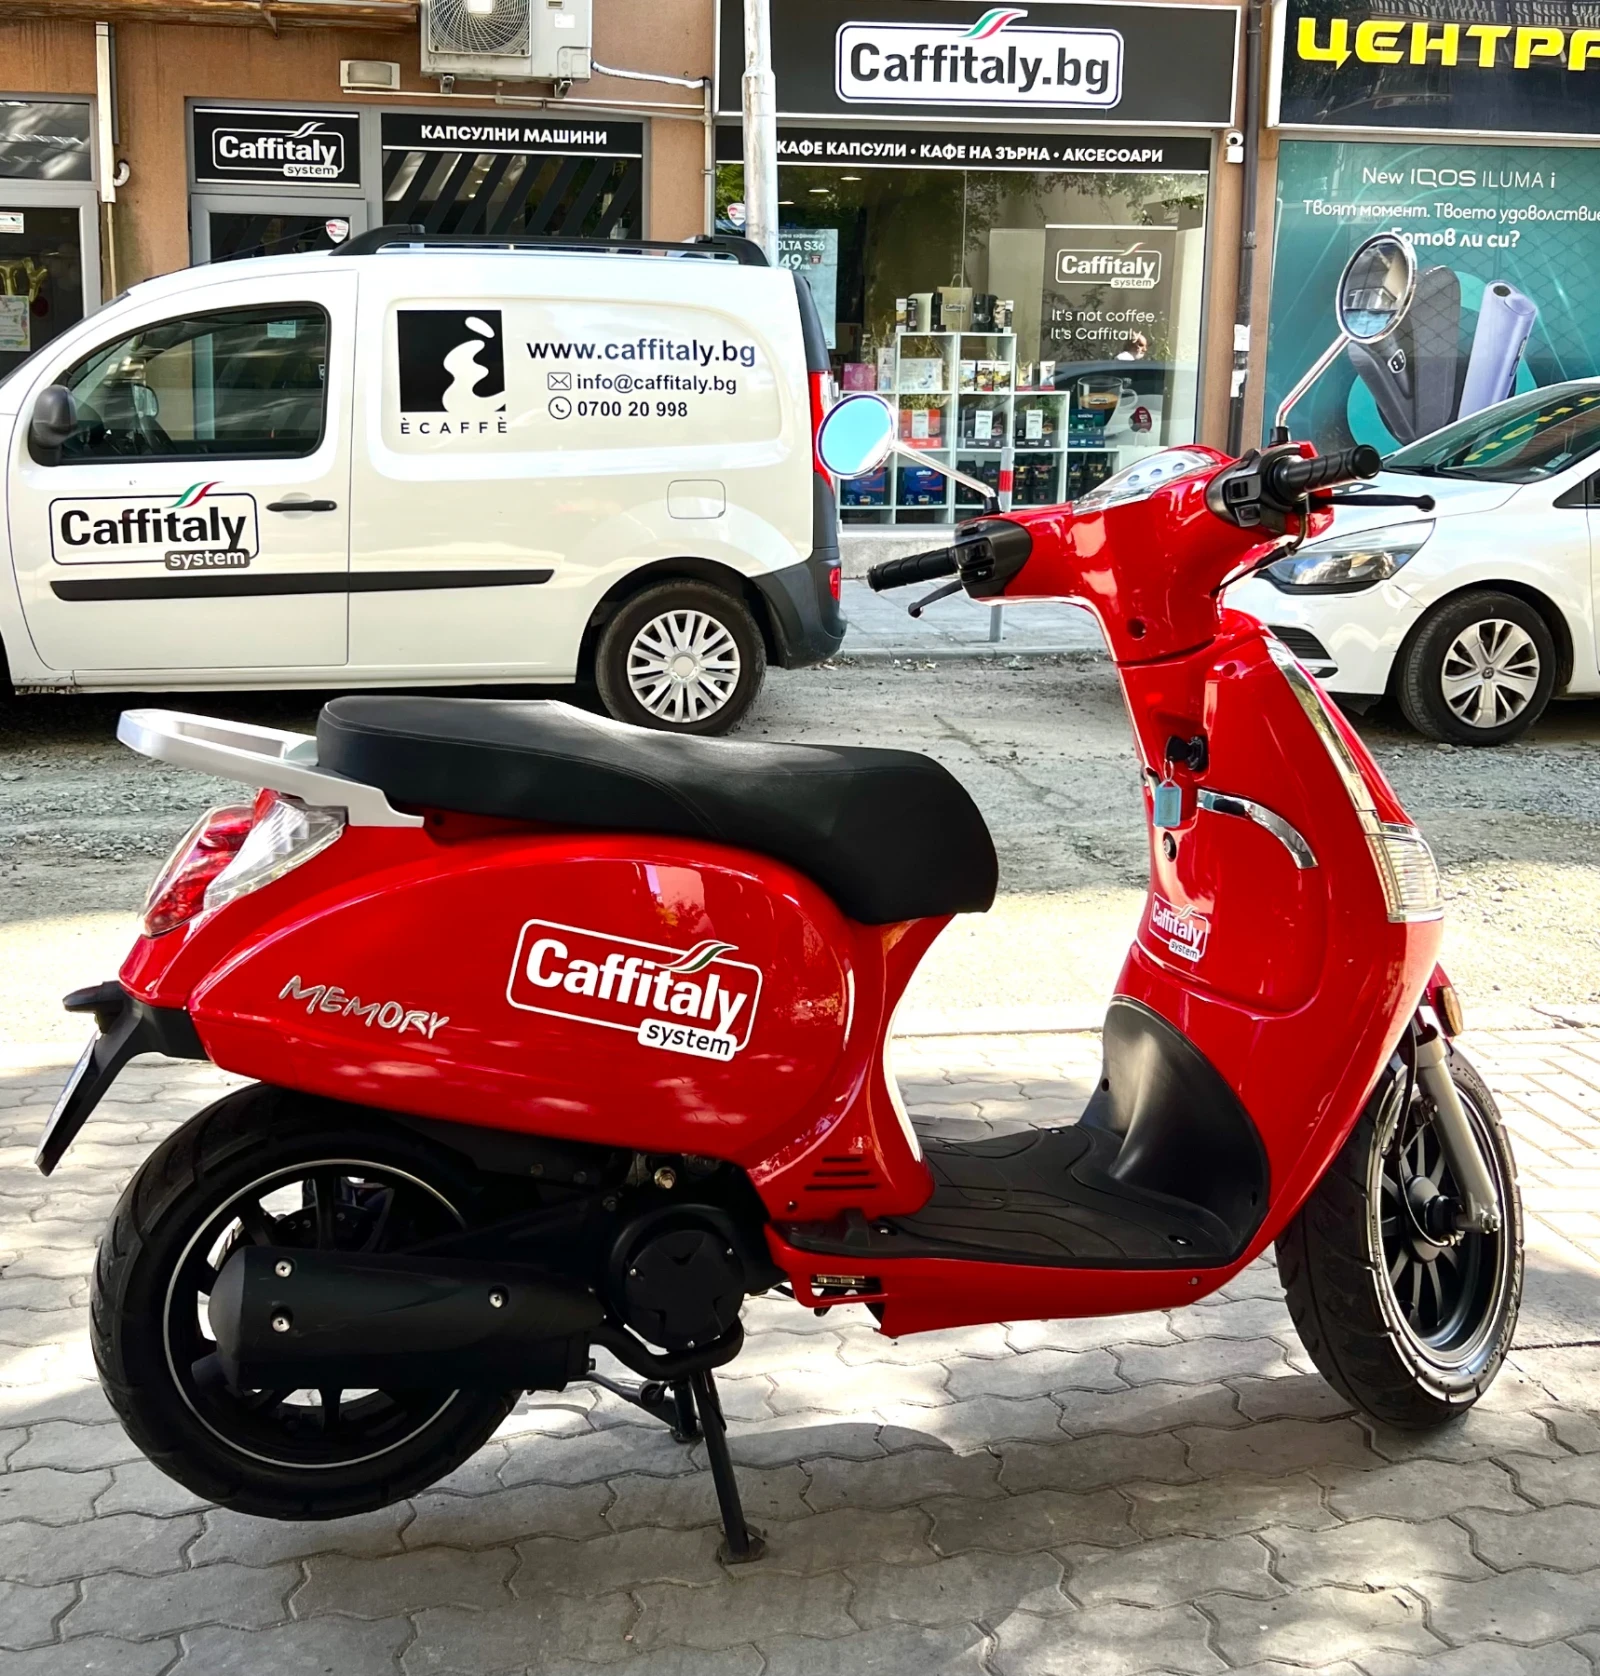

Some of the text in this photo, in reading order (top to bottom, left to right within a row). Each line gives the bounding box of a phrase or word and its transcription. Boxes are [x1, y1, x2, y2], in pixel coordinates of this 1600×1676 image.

[850, 42, 1110, 95] Caffitaly.bg
[420, 125, 607, 145] КАПСУЛНИ МАШИНИ
[219, 135, 337, 167] Caffitaly
[776, 139, 1164, 163] КАФЕ КАПСУЛИ КАФЕ НА ЗЪРНА АКСЕСОАРИ
[287, 165, 335, 176] system
[1362, 167, 1556, 189] New IQOS ILUMA i
[1302, 200, 1356, 216] Твоят
[1359, 204, 1431, 219] момент.
[1433, 203, 1497, 220] Твоето
[803, 240, 826, 251] S36
[1459, 234, 1483, 248] ли
[1486, 229, 1521, 248] си?
[1061, 255, 1156, 281] Caffitaly
[1113, 278, 1153, 288] system
[1051, 309, 1073, 321] It's
[1076, 310, 1103, 322] not
[1050, 327, 1072, 340] It's
[526, 338, 756, 367] www.caffitaly.bg
[576, 374, 737, 395] info@caffitaly.bg
[577, 401, 688, 417] 0700 20 998
[61, 506, 247, 551] Caffitaly
[170, 551, 246, 569] system
[1152, 900, 1204, 949] Caffitaly
[1170, 940, 1199, 960] system
[525, 938, 749, 1036] Caffitaly
[277, 974, 451, 1040] MEMORY
[645, 1020, 732, 1057] system
